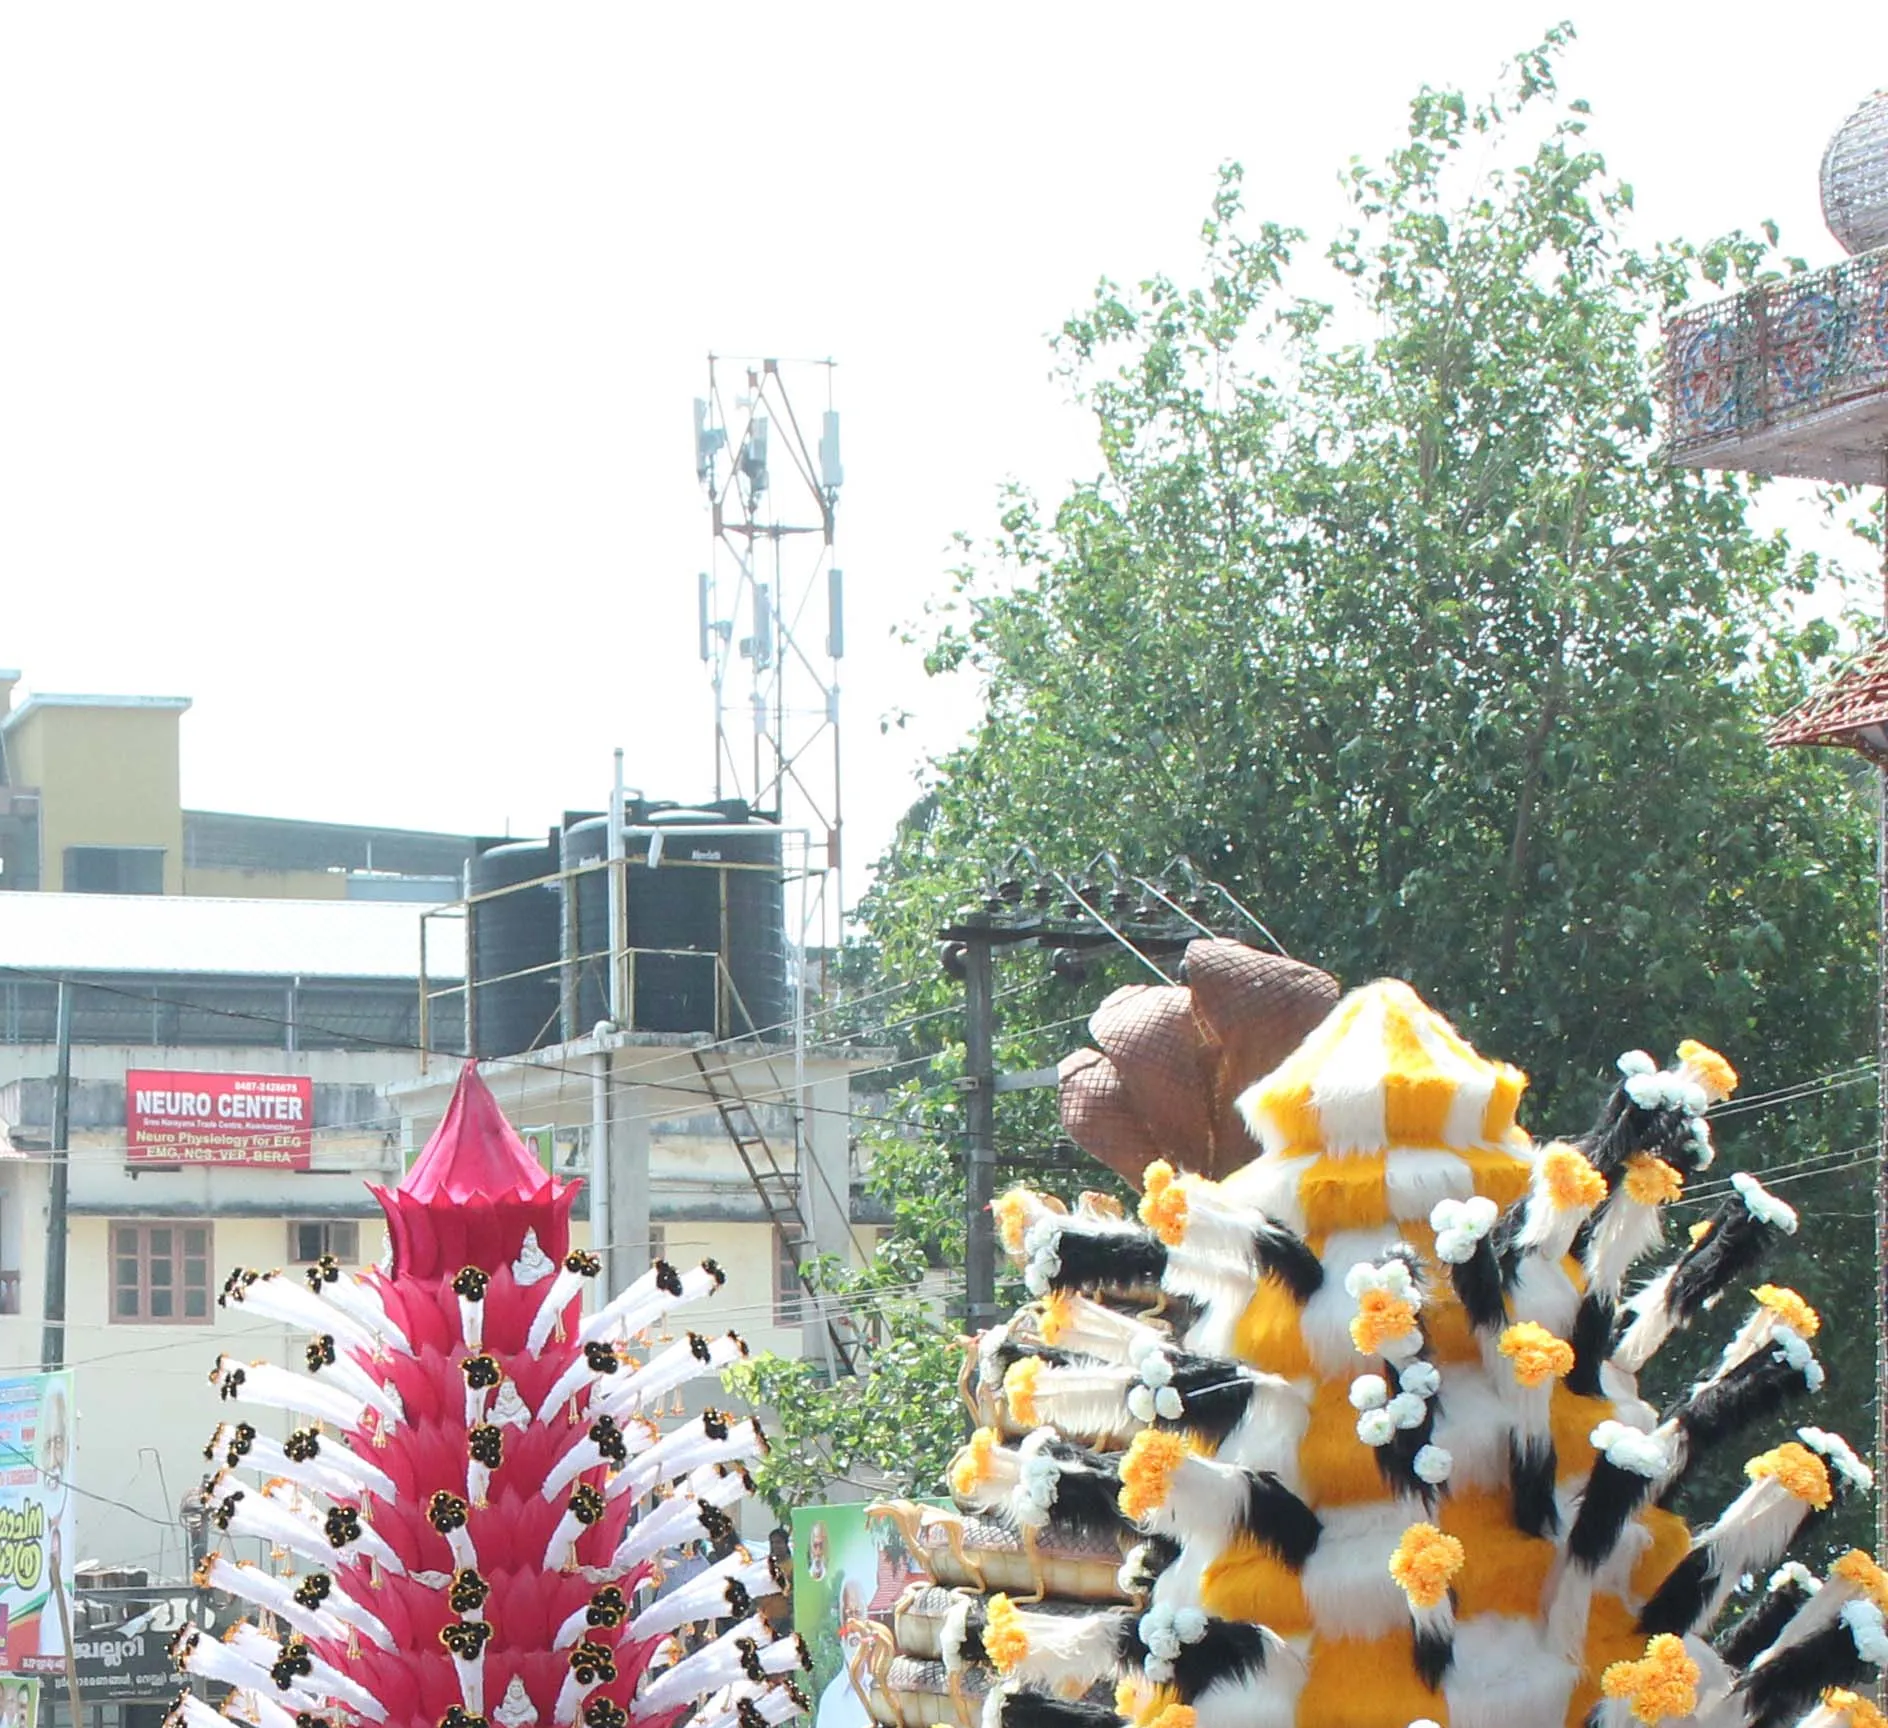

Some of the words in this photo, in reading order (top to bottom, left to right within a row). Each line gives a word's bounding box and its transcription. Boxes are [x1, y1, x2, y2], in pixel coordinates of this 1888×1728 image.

[135, 1090, 212, 1117] NEURO
[217, 1094, 303, 1120] CENTER
[135, 1130, 175, 1144] Neuro
[178, 1132, 248, 1148] Physiology
[251, 1133, 271, 1147] for
[274, 1135, 301, 1148] EEG
[254, 1150, 291, 1163] BERA
